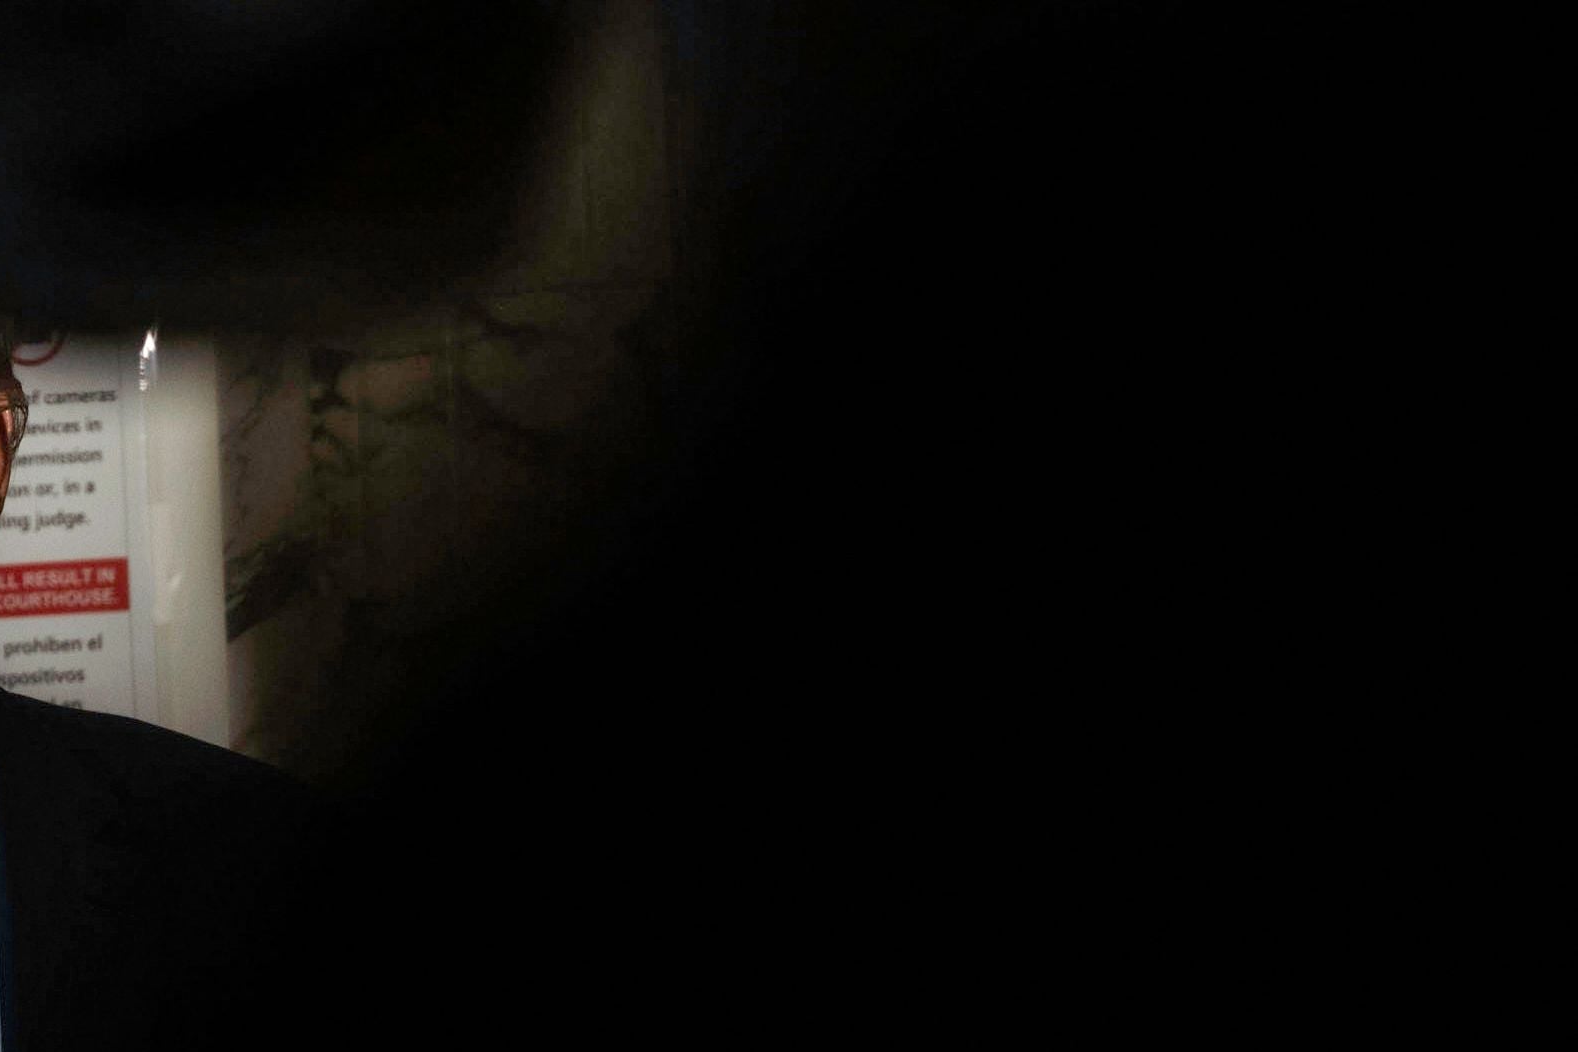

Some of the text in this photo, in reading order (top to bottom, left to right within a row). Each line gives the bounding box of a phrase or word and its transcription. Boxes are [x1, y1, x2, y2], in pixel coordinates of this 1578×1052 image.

[43, 390, 117, 404] cameras
[85, 417, 103, 432] in
[63, 478, 81, 495] in
[84, 480, 96, 494] a
[22, 567, 95, 589] RESULT
[96, 567, 116, 584] IN
[87, 633, 103, 650] el
